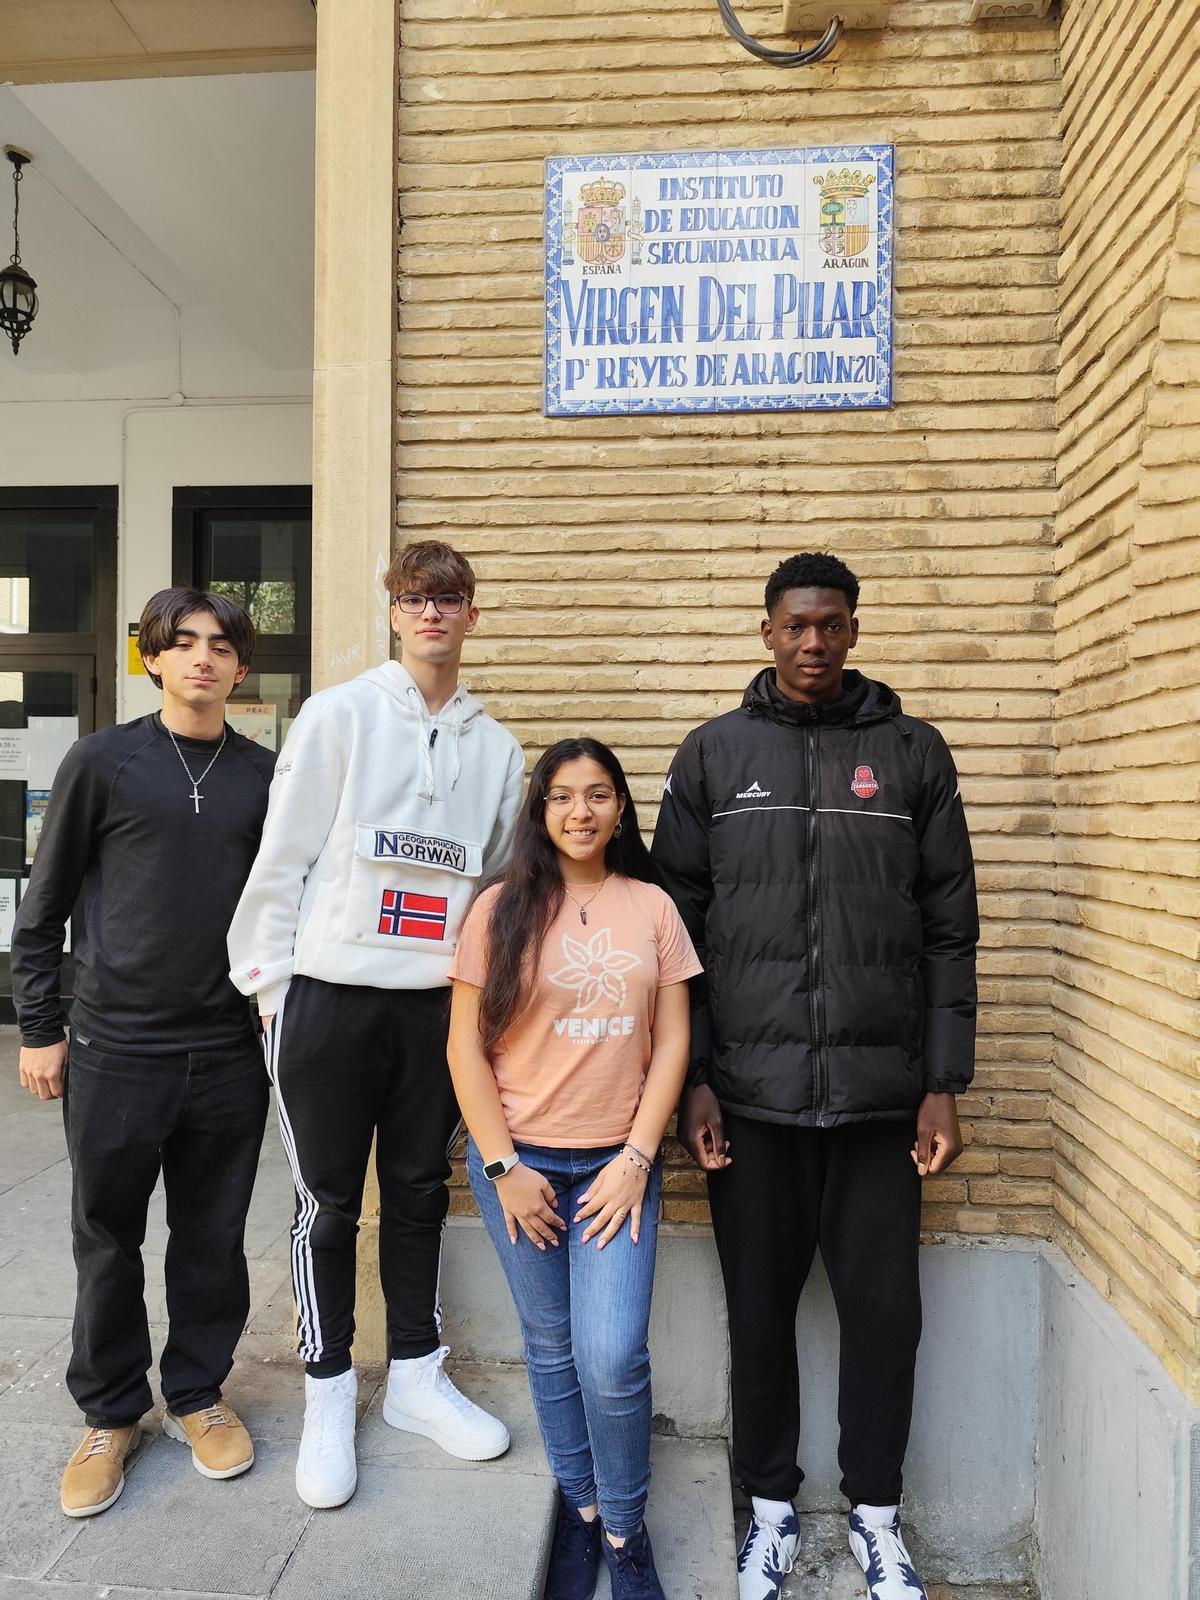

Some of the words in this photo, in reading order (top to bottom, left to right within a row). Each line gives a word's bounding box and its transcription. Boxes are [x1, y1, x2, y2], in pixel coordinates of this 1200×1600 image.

[658, 174, 784, 201] INSTITUTO
[643, 208, 673, 233] DE
[679, 204, 800, 232] EDUCACION
[647, 237, 800, 264] SECUNDARIA
[561, 278, 685, 346] VIRGEN
[696, 275, 762, 343] DEL
[771, 273, 878, 341] PILAR
[594, 355, 688, 390] REYES
[694, 353, 728, 387] DE
[729, 351, 834, 386] ARAGON
[735, 791, 771, 799] MERCURY
[378, 832, 460, 867] NORWAY
[553, 1015, 635, 1038] VENICE
